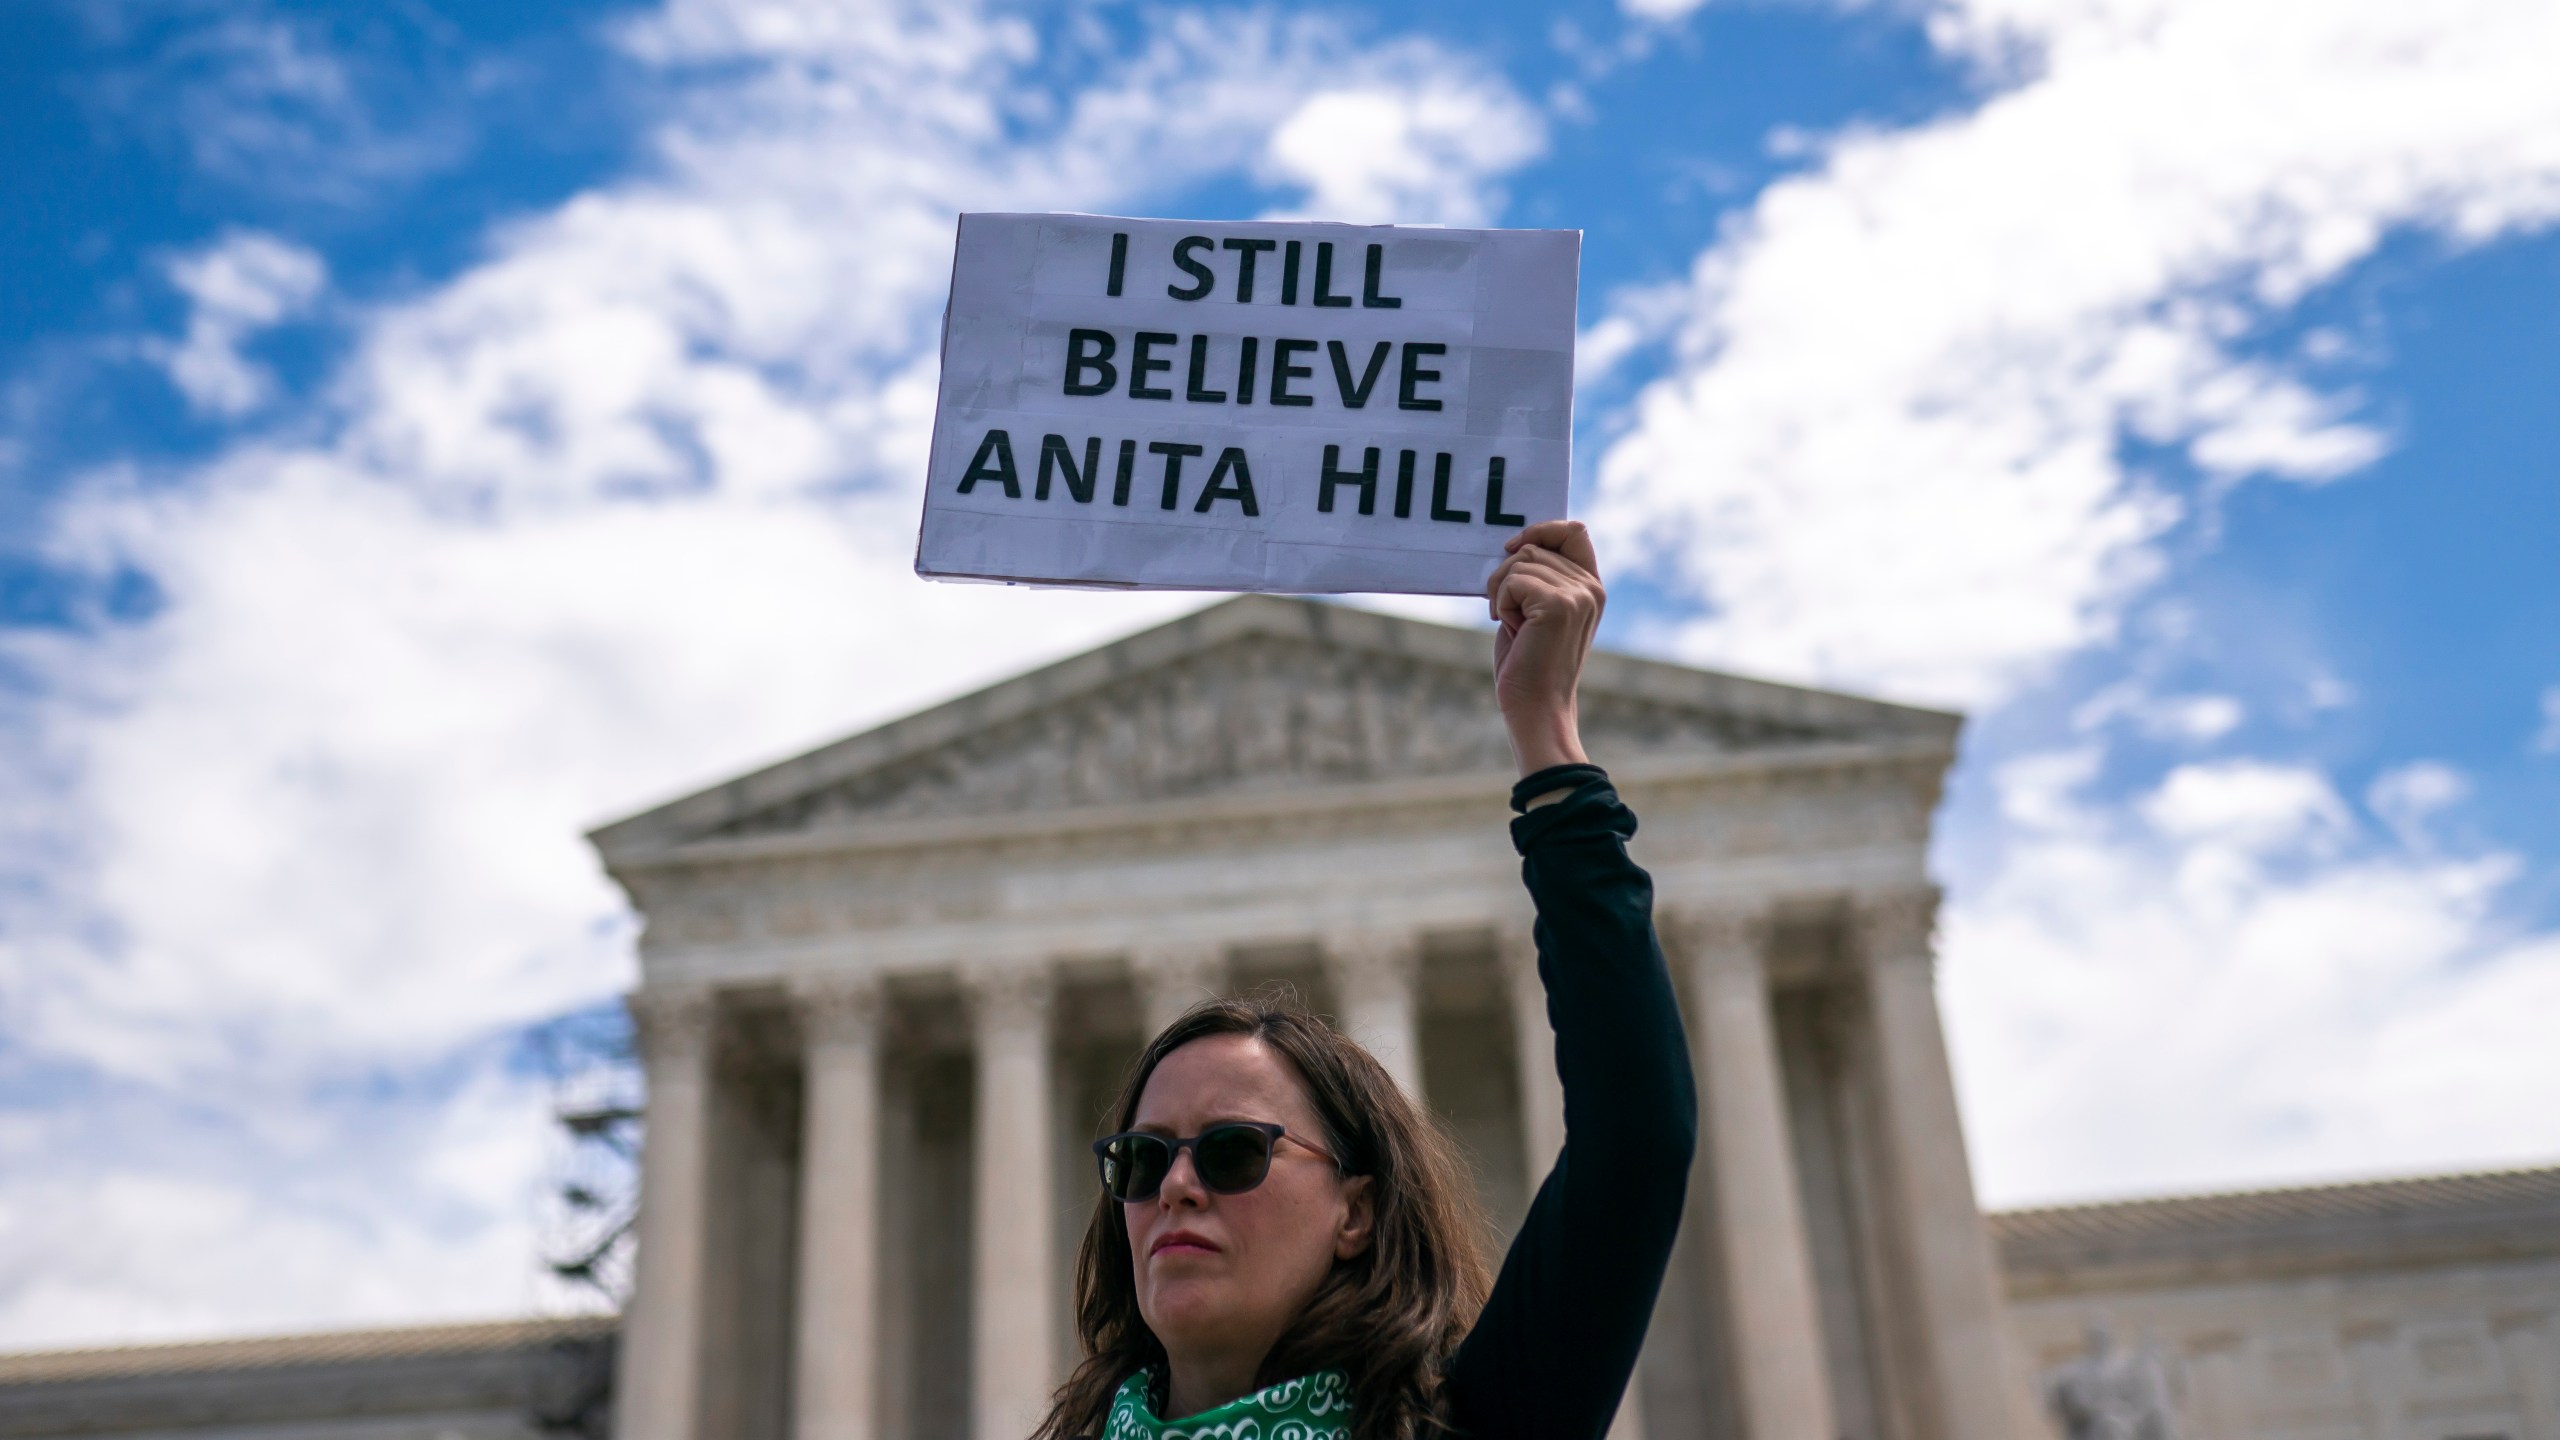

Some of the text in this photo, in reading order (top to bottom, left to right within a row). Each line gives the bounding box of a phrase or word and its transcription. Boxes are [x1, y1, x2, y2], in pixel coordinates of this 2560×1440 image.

[1107, 233, 1402, 309] I STILL
[1063, 328, 1447, 412] BELIEVE
[956, 429, 1526, 528] ANITA HILL
